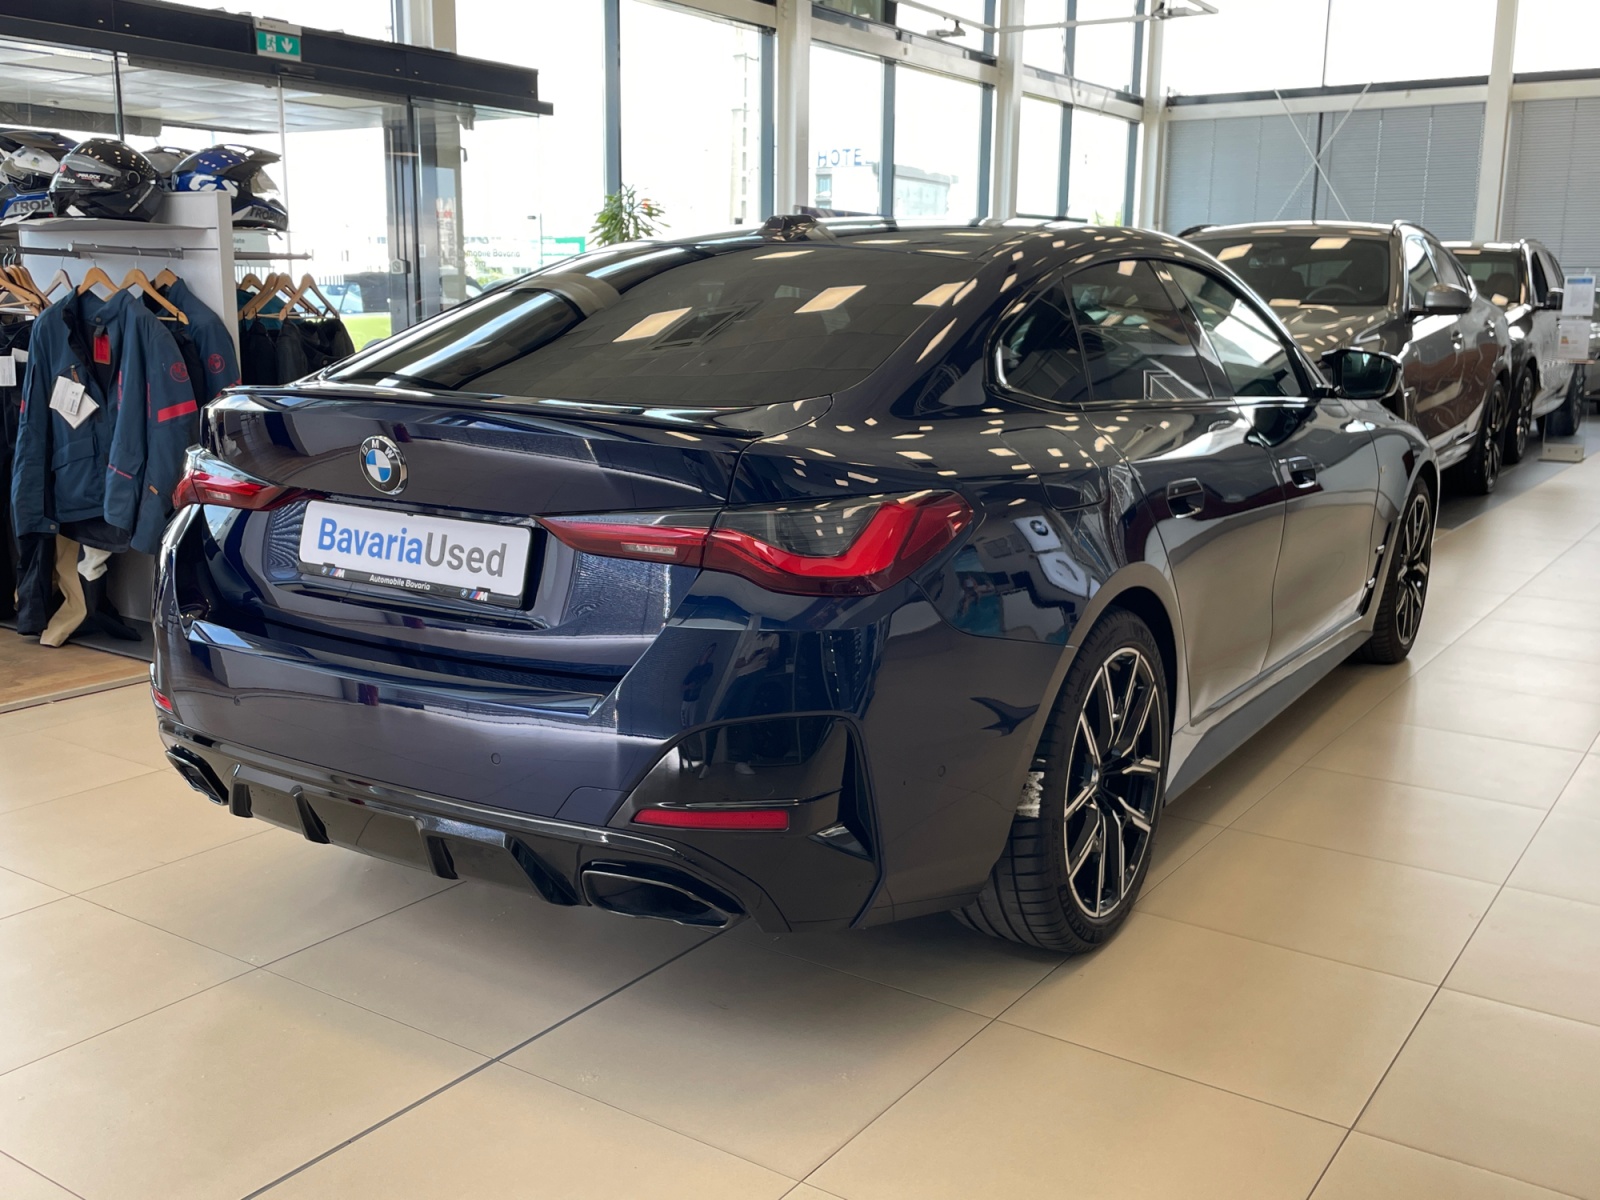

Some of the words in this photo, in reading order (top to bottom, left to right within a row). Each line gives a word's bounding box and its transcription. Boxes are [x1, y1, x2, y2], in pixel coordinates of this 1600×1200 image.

[818, 148, 873, 167] HOTE
[361, 439, 395, 459] BMW
[318, 518, 507, 578] BavariaUsed
[369, 574, 405, 588] Automobile
[405, 579, 431, 591] Bavaria
